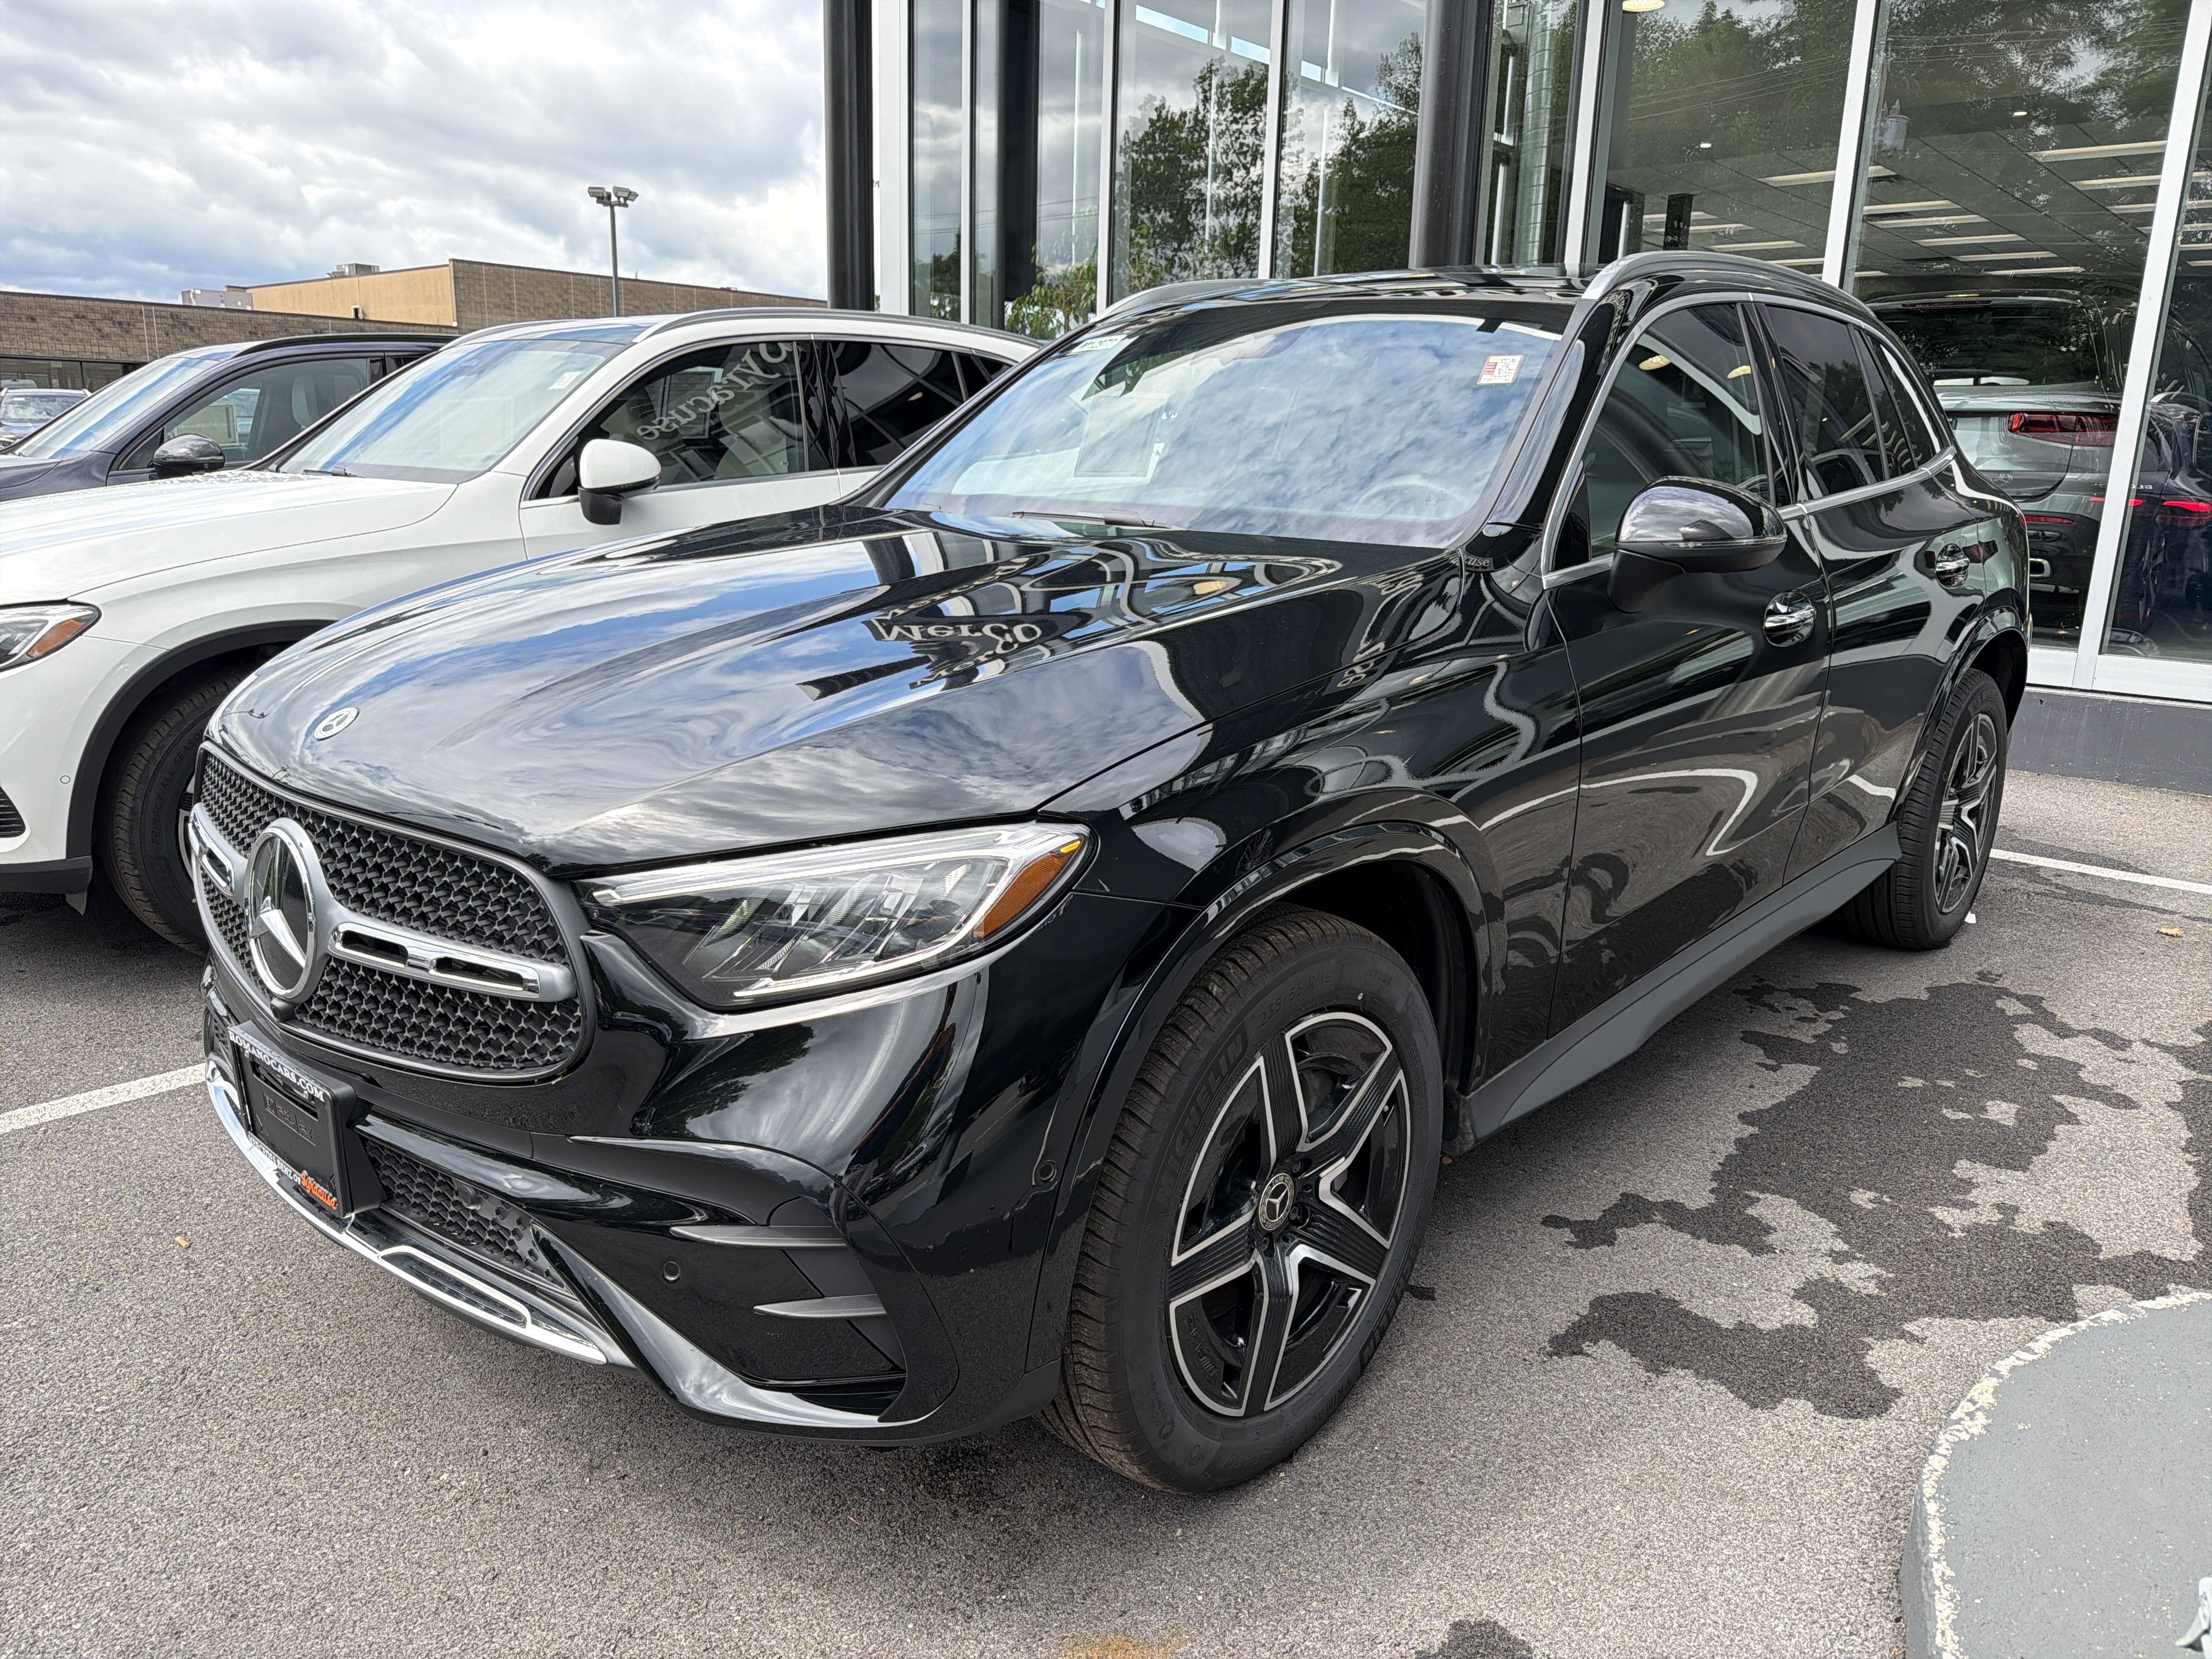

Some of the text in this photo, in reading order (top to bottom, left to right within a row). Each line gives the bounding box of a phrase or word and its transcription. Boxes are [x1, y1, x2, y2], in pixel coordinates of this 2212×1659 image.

[160, 769, 176, 792] ALL
[173, 730, 203, 765] SEASO
[1261, 980, 1305, 1028] 235/55
[1308, 975, 1316, 992] R
[1321, 970, 1333, 984] 19
[228, 1030, 325, 1102] ROMANOCARS.COM
[1156, 1034, 1243, 1207] MICHELIN
[301, 1171, 338, 1210] Syracuse
[1272, 1176, 1284, 1186] BENZ
